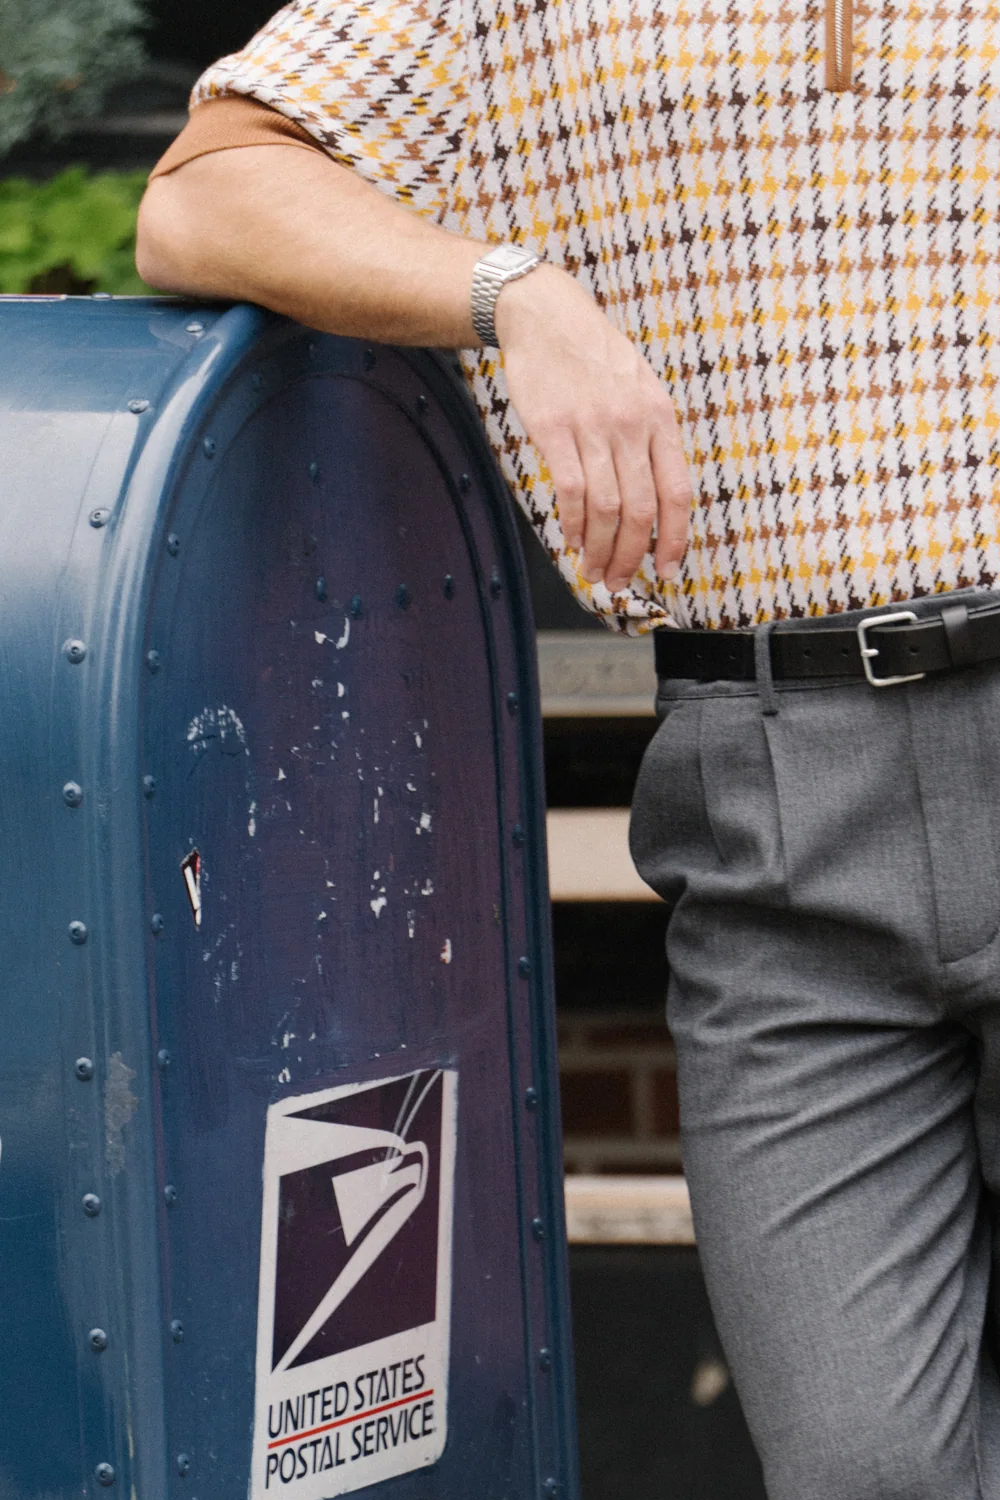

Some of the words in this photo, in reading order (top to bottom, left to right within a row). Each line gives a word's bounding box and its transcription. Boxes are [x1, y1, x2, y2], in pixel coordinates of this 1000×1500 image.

[268, 1381, 349, 1439] UNITED
[353, 1354, 425, 1411] STATES
[265, 1432, 346, 1490] POSTAL
[351, 1400, 434, 1461] SERVICE
